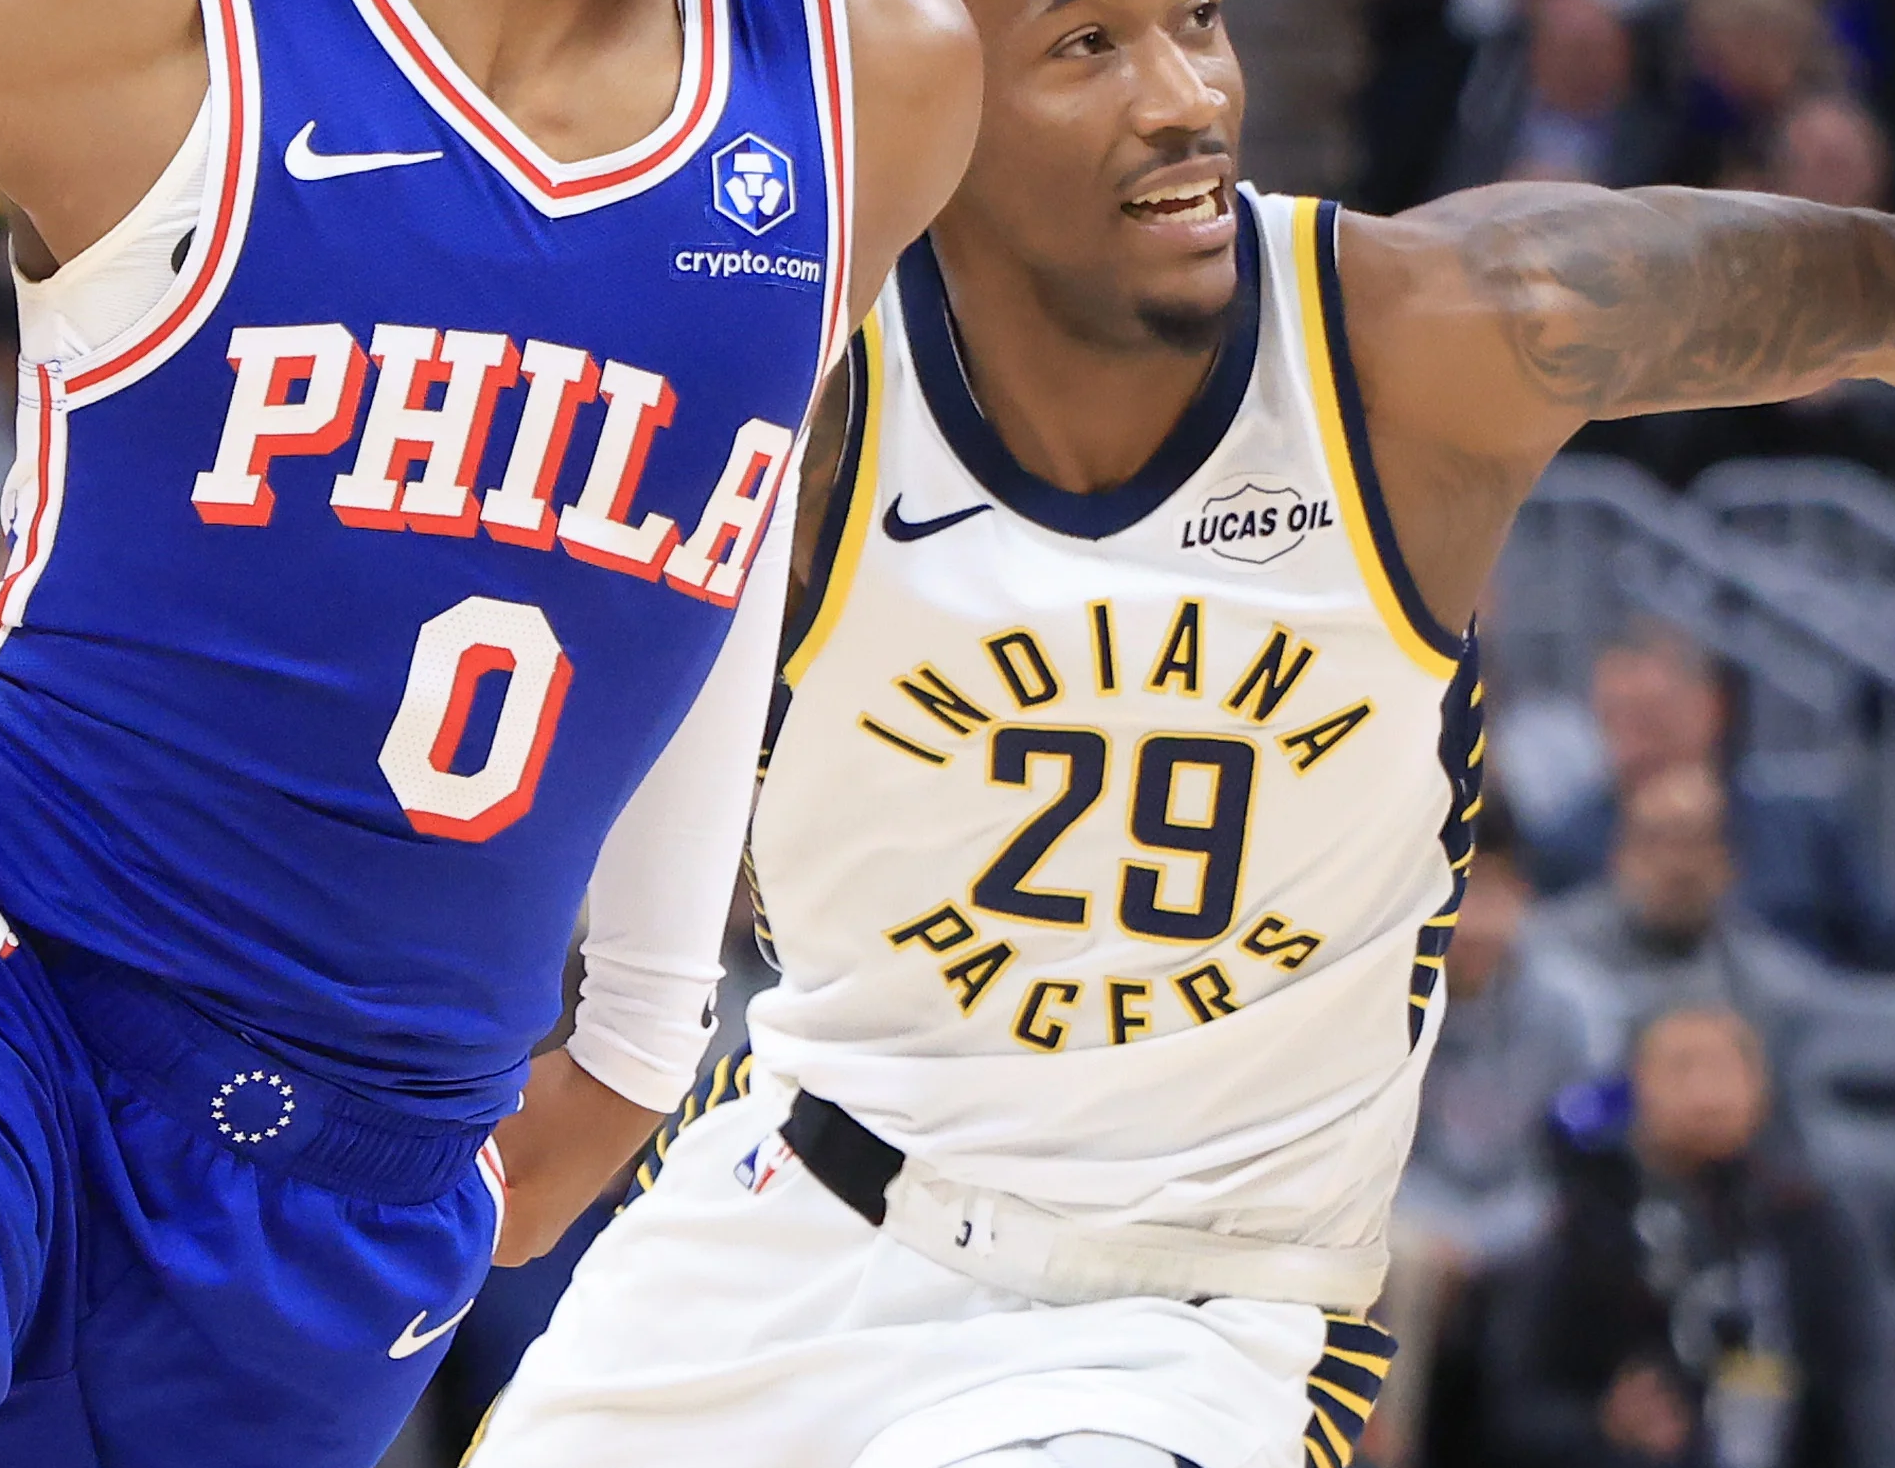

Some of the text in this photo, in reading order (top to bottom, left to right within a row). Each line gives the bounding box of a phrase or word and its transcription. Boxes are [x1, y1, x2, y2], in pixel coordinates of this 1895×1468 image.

[675, 249, 820, 283] crypto.com
[190, 323, 795, 608] PHILA
[1181, 500, 1333, 549] LUCAS OIL
[378, 596, 573, 843] 0
[857, 598, 1370, 774] INDIANA
[970, 724, 1260, 946] 29
[881, 899, 1326, 1054] PACERS
